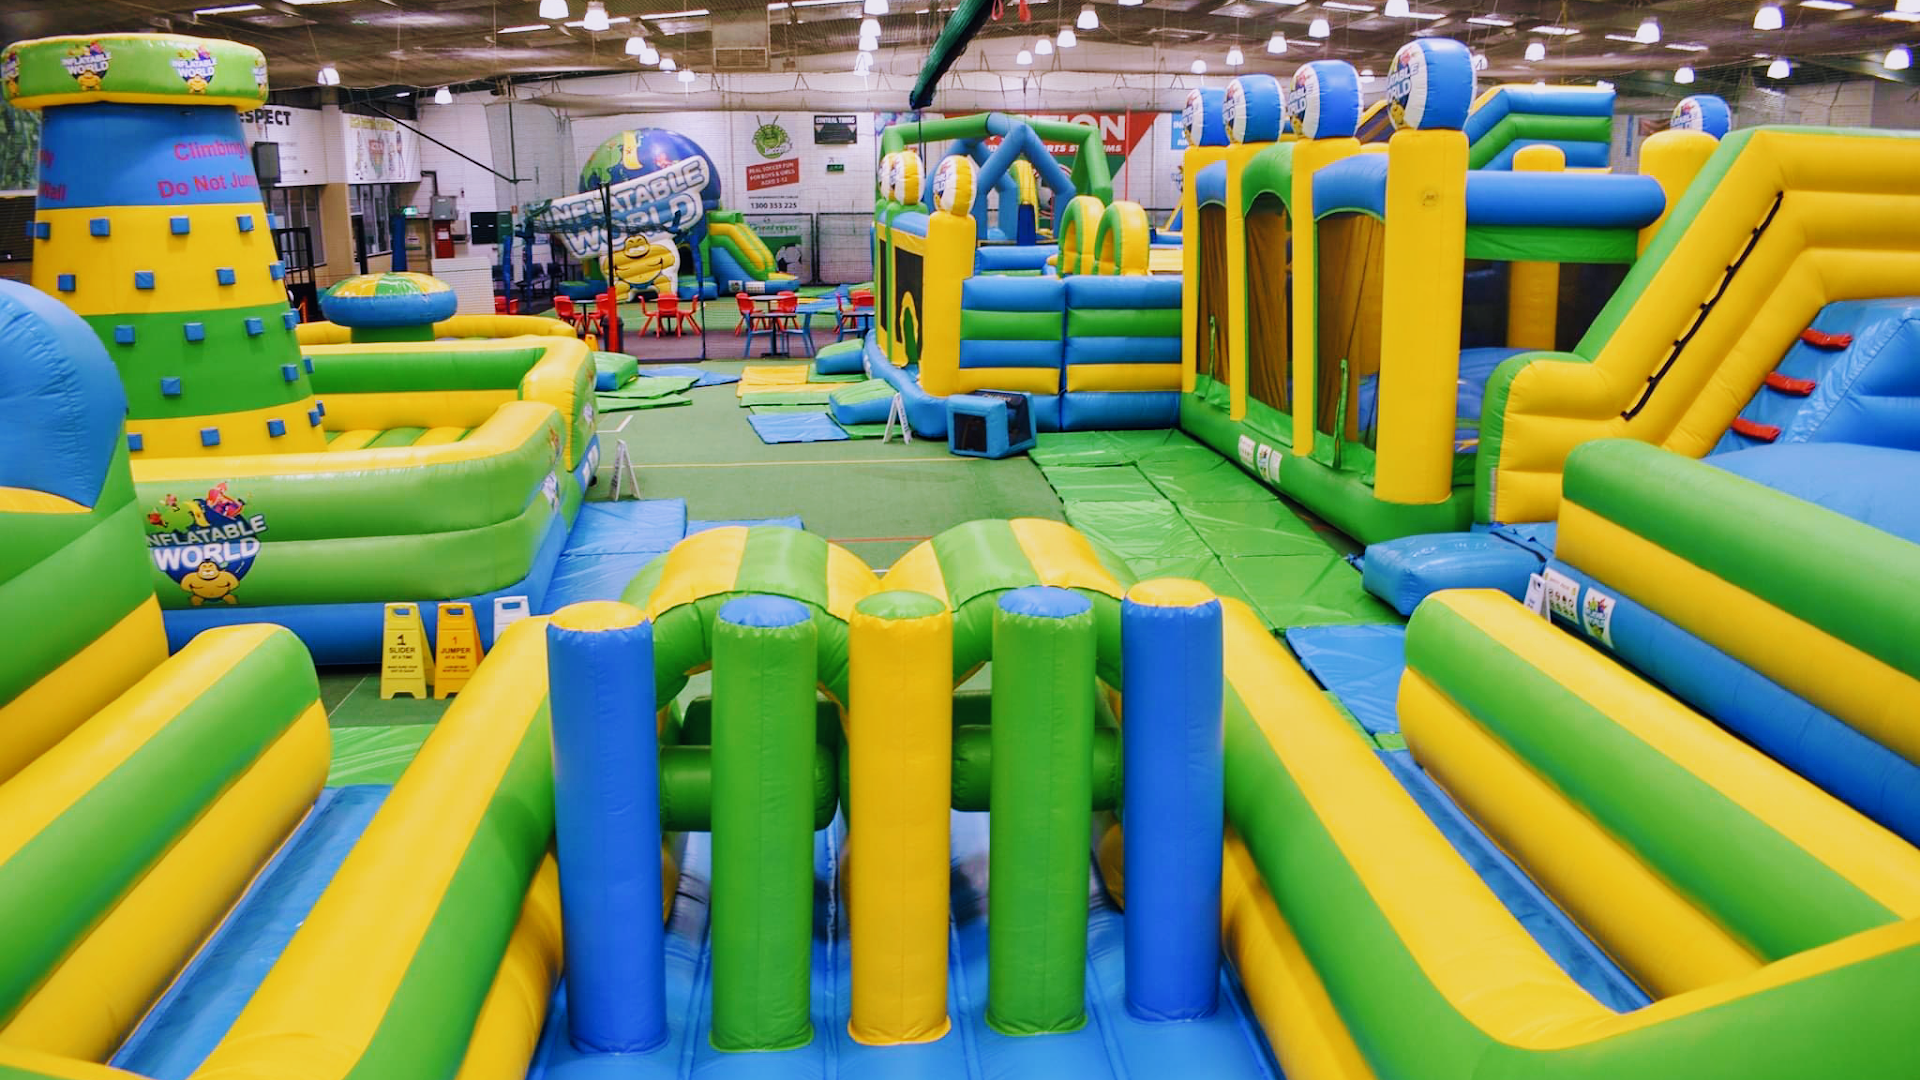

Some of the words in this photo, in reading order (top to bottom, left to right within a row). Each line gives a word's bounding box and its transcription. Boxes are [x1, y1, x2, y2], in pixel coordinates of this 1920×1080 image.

[67, 61, 109, 75] WORLD
[179, 66, 215, 78] WORLD
[240, 108, 292, 126] ESPECT
[158, 179, 189, 199] Do
[193, 173, 226, 191] Not
[147, 514, 268, 547] NFLATABLE
[153, 536, 261, 571] WORLD
[397, 634, 406, 646] 1
[452, 635, 458, 645] 1
